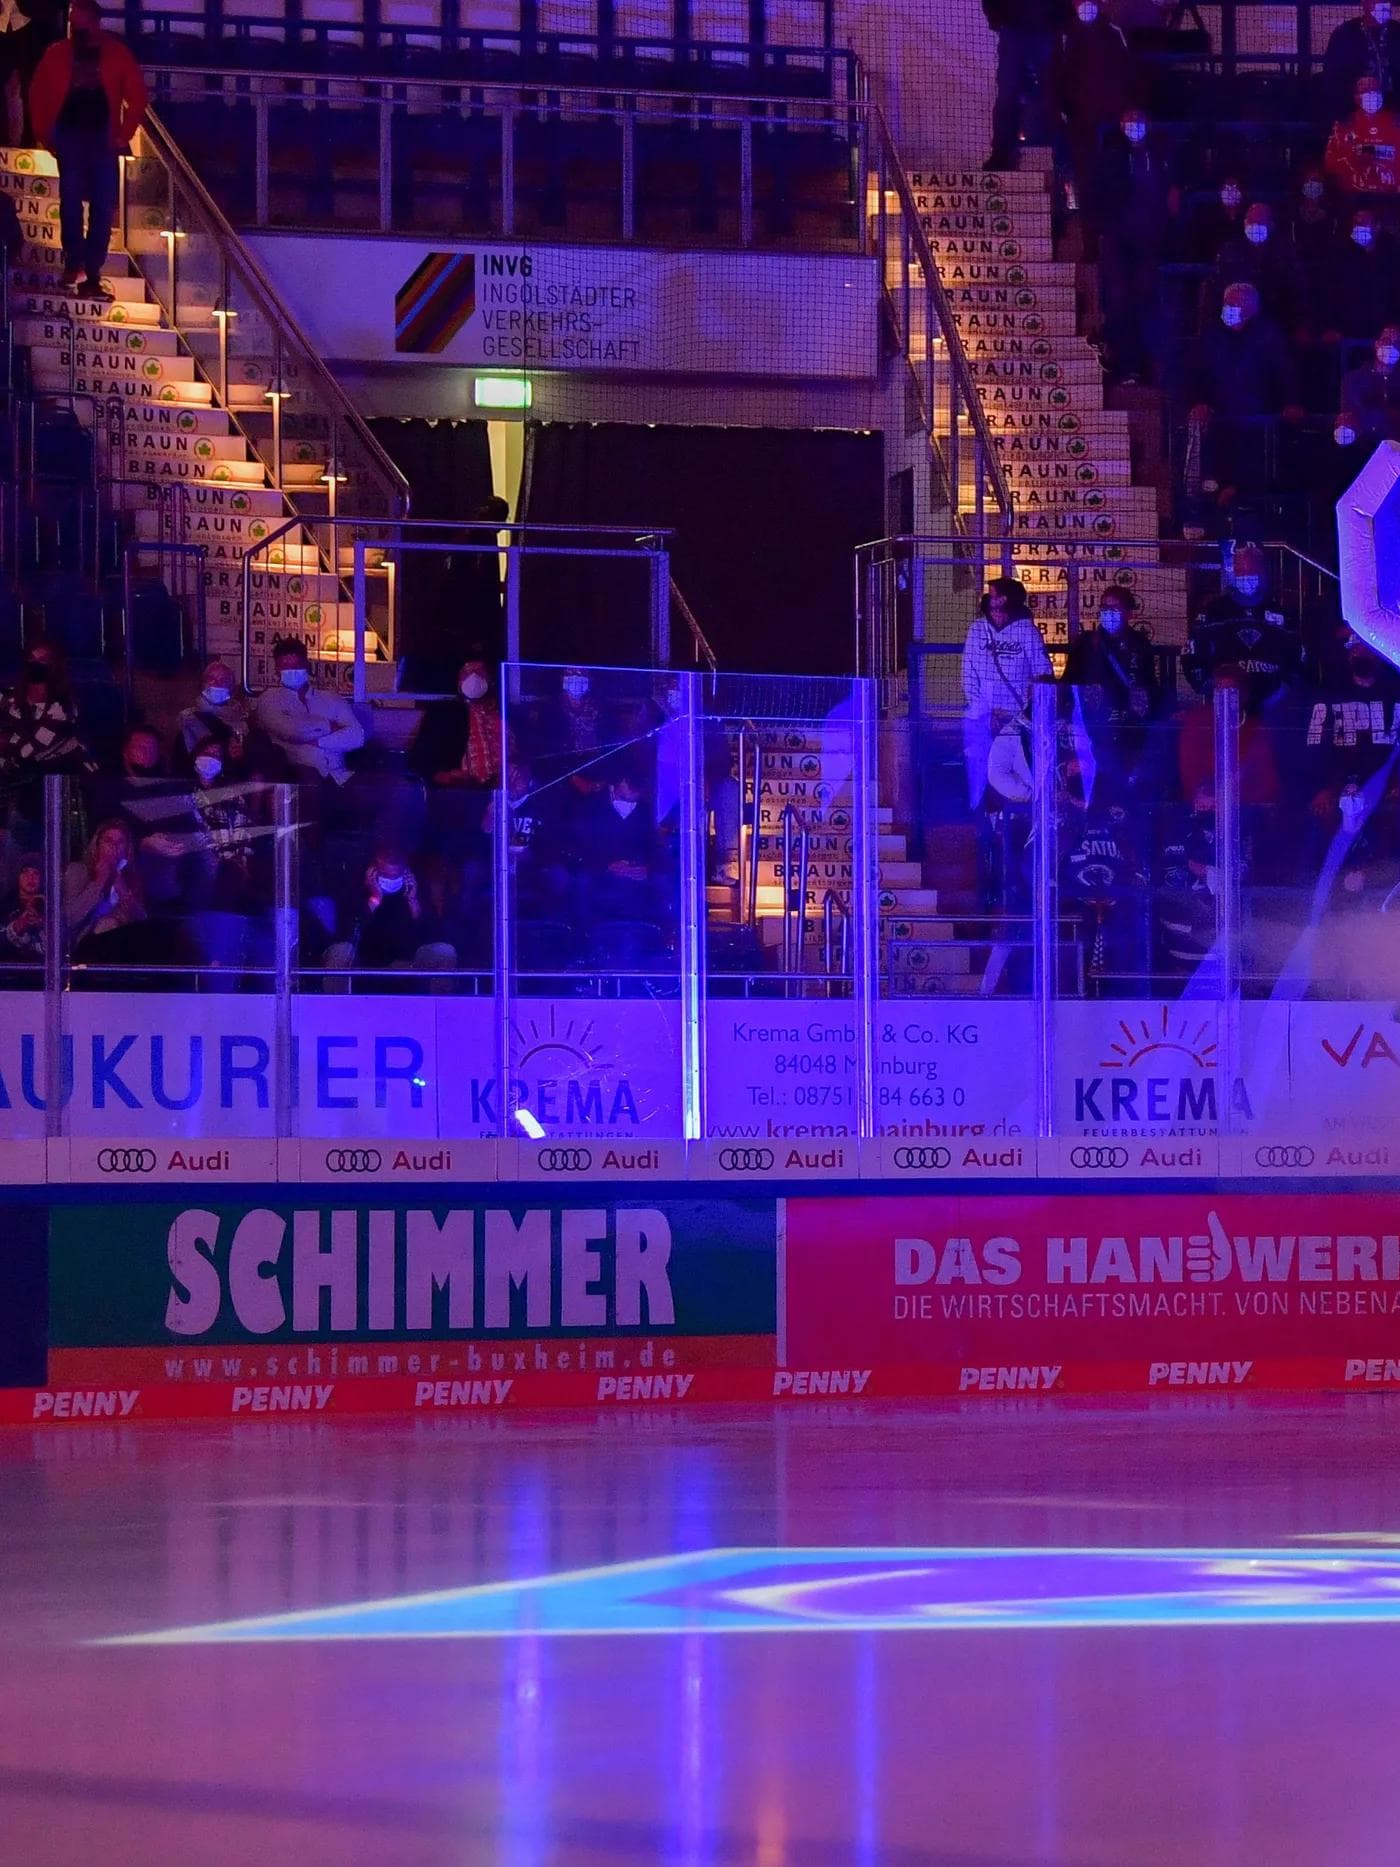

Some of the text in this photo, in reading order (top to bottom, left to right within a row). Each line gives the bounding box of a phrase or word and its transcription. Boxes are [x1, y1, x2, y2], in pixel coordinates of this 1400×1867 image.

[912, 175, 975, 187] RAUN
[917, 195, 980, 208] RAUN
[922, 216, 985, 229] RAUN
[930, 240, 993, 253] RAUN
[482, 254, 533, 277] INVG
[945, 289, 1008, 302] RAUN
[482, 309, 601, 333] VERKEHRS-
[953, 313, 1016, 327] RAUN
[44, 325, 120, 344] BRAUN
[482, 336, 640, 361] GESELLSCHAFT
[960, 340, 1023, 353] RAUN
[60, 352, 136, 371] BRAUN
[970, 362, 1033, 376] RAUN
[76, 380, 152, 397] BRAUN
[976, 387, 1041, 401] RAUN
[95, 405, 171, 424] BRAUN
[110, 431, 188, 451] BRAUN
[994, 437, 1059, 451] RAUN
[127, 460, 206, 477] BRAUN
[1002, 464, 1068, 478] RAUN
[146, 485, 225, 505] BRAUN
[1010, 490, 1076, 504] RAUN
[163, 514, 243, 533] BRAUN
[1018, 514, 1086, 528] RAUN
[201, 544, 260, 561] RAUN
[203, 572, 281, 590] BRAUN
[1028, 594, 1096, 608] BRAU
[257, 659, 338, 679] BUN
[744, 782, 807, 796] RAUN
[773, 864, 853, 878] BRAUN
[733, 1022, 979, 1045] Krema Gmb & Co. KG
[774, 1055, 837, 1075] 84048
[470, 1078, 640, 1125] KREMA
[747, 1086, 787, 1106] Tel.:
[879, 1087, 902, 1106] 84
[909, 1087, 945, 1107] 663
[953, 1087, 965, 1107] 0
[1075, 1077, 1256, 1122] KREMA
[167, 1149, 230, 1172] Audi
[392, 1149, 452, 1171] Audi
[601, 1149, 660, 1170] Audi
[784, 1148, 844, 1169] Audi
[961, 1148, 1023, 1168] Audi
[1139, 1147, 1202, 1167] Audi
[1325, 1146, 1390, 1166] Audi
[163, 1207, 676, 1336] SCHIMMER
[893, 1237, 1021, 1286] DAS
[894, 1294, 934, 1319] DIE
[940, 1292, 1227, 1318] WIRTSCHAFTSMACHT.
[1236, 1292, 1288, 1315] VON
[165, 1340, 677, 1380] www.schimmer-buxheim.de
[772, 1369, 872, 1395] PENNY
[959, 1365, 1062, 1391] PENNY
[1147, 1361, 1254, 1386] PENNY
[415, 1380, 513, 1406] PENNY
[597, 1374, 695, 1401] PENNY
[33, 1390, 140, 1419] PENNY
[231, 1385, 334, 1412] PENNY
